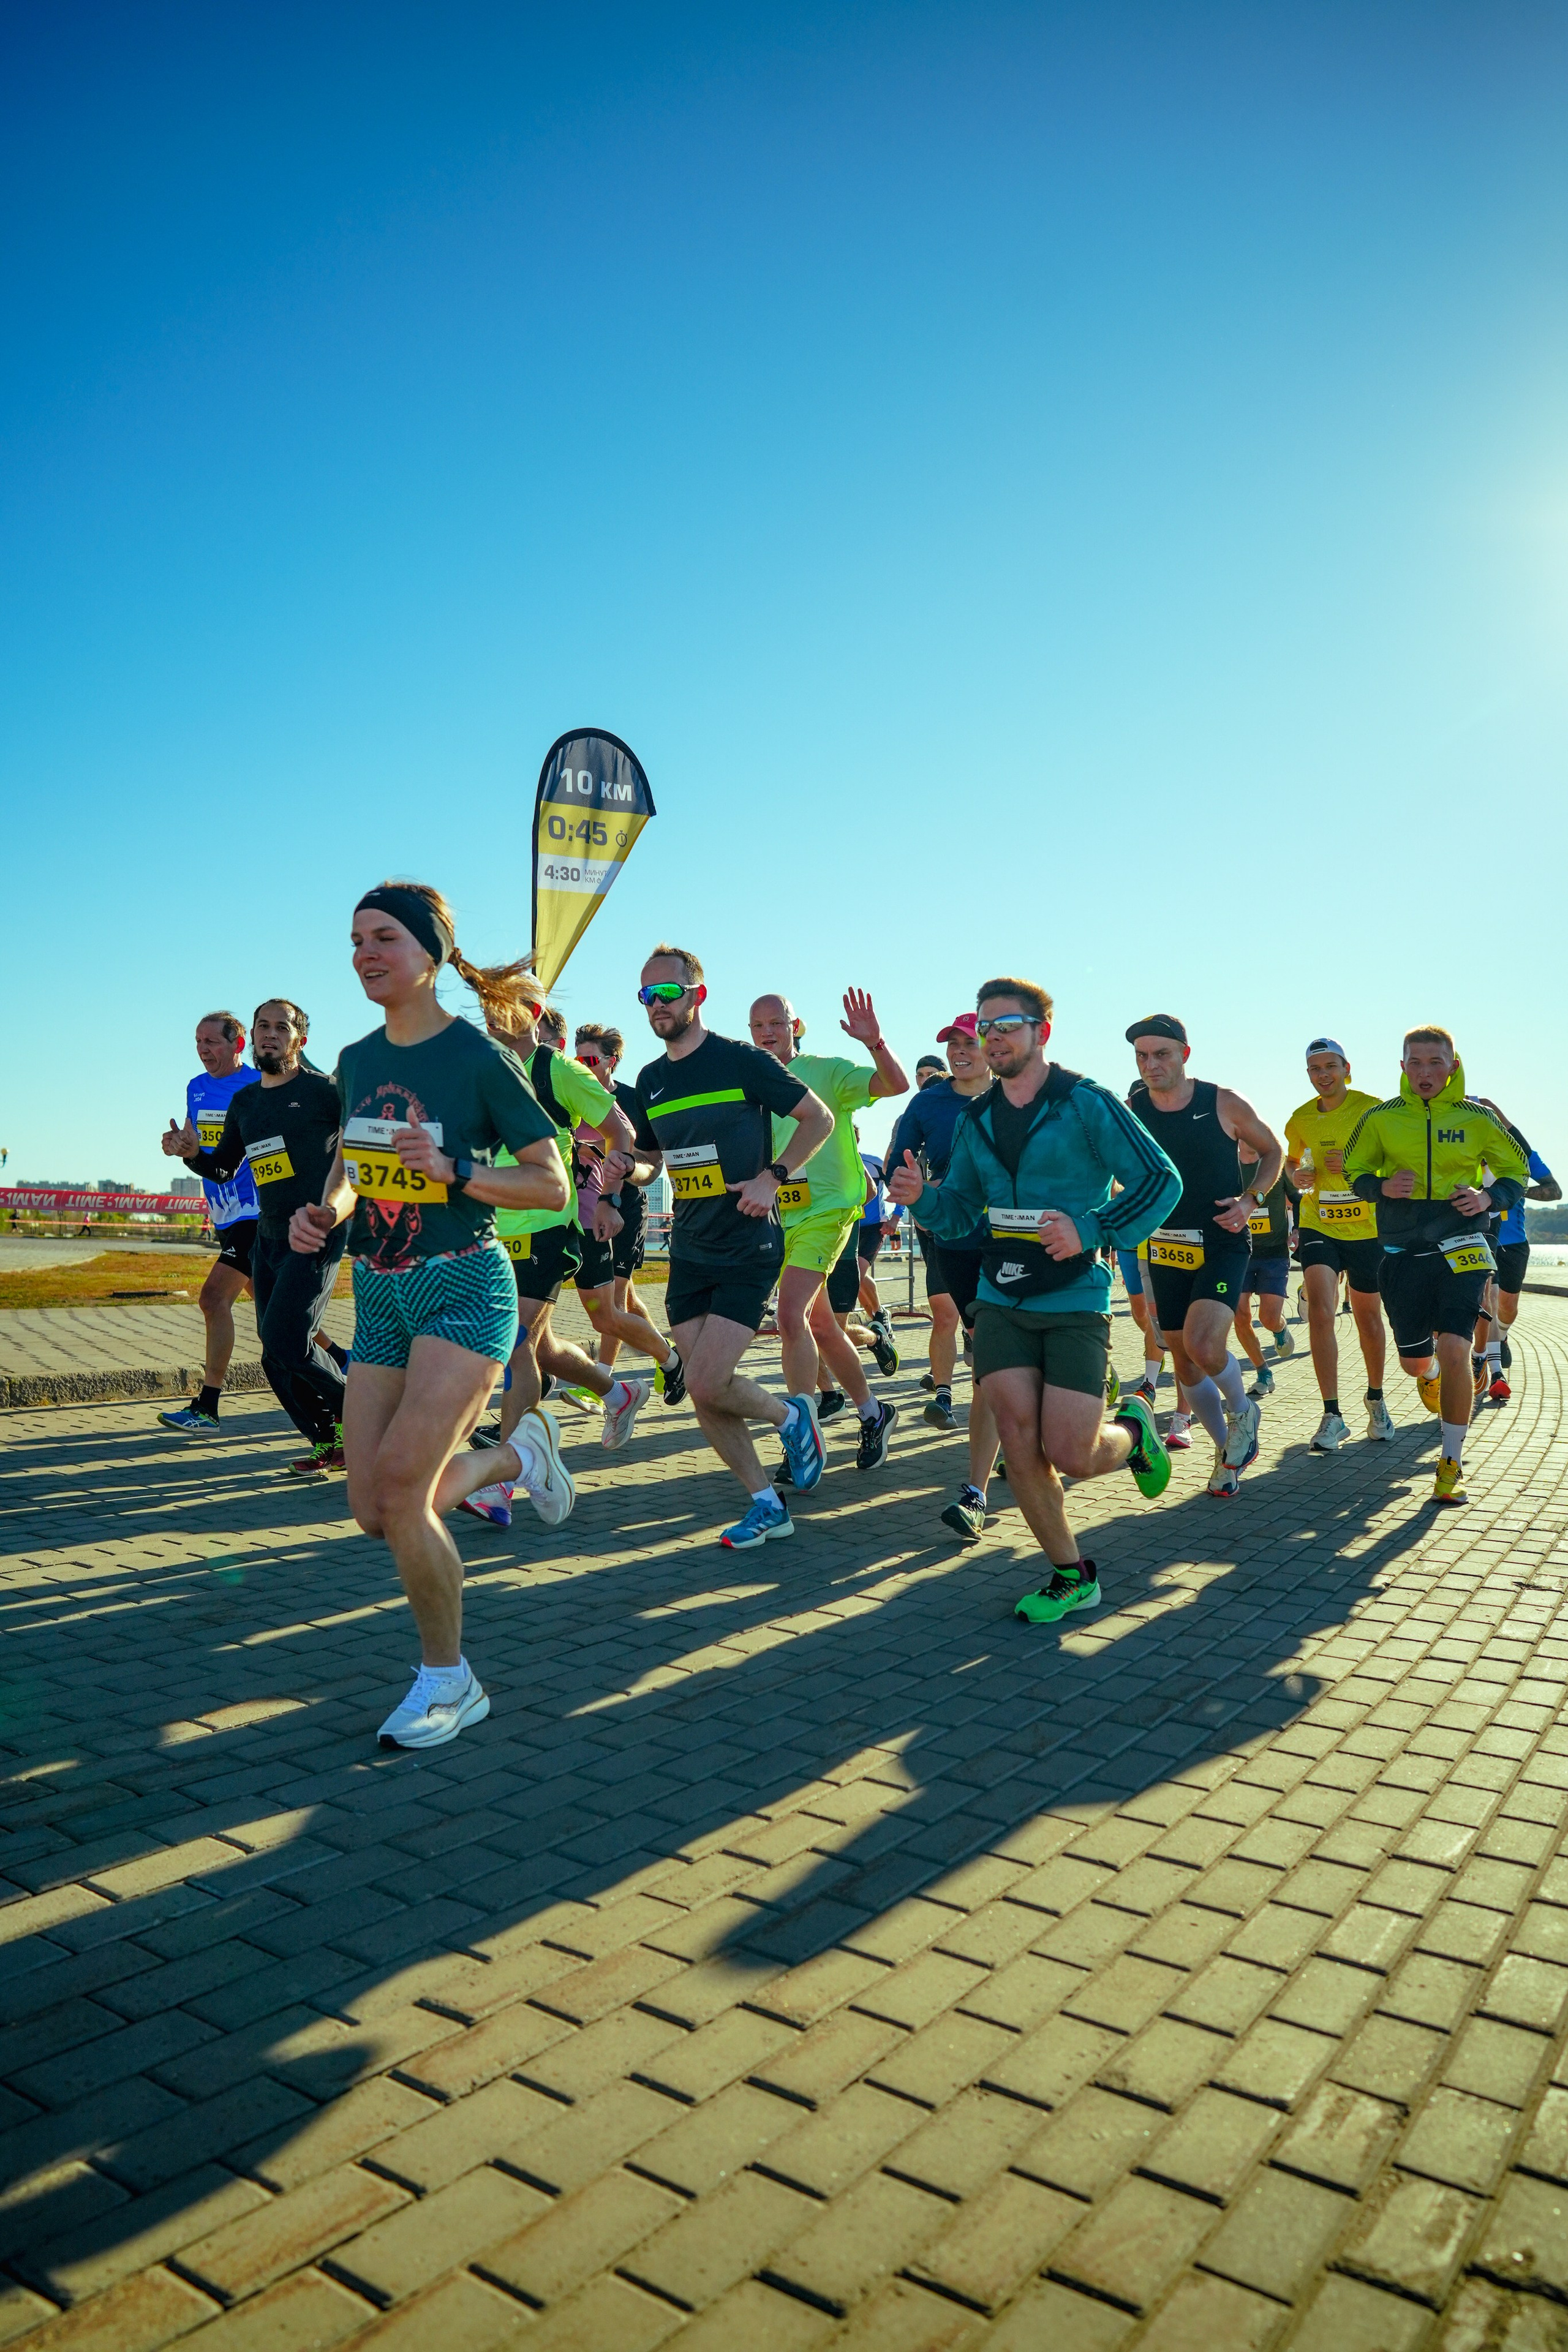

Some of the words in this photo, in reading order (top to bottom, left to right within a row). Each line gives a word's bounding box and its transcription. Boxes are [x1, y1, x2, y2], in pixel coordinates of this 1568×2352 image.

[560, 767, 593, 795] 10
[548, 815, 608, 846] 0:45
[544, 864, 581, 882] 4:30
[347, 1167, 356, 1179] B
[360, 1163, 426, 1191] 3745
[675, 1174, 713, 1192] 3714
[1327, 1207, 1361, 1219] 3330
[1159, 1247, 1194, 1264] 3658
[1458, 1253, 1492, 1266] 3846
[1001, 1262, 1025, 1276] NIKE
